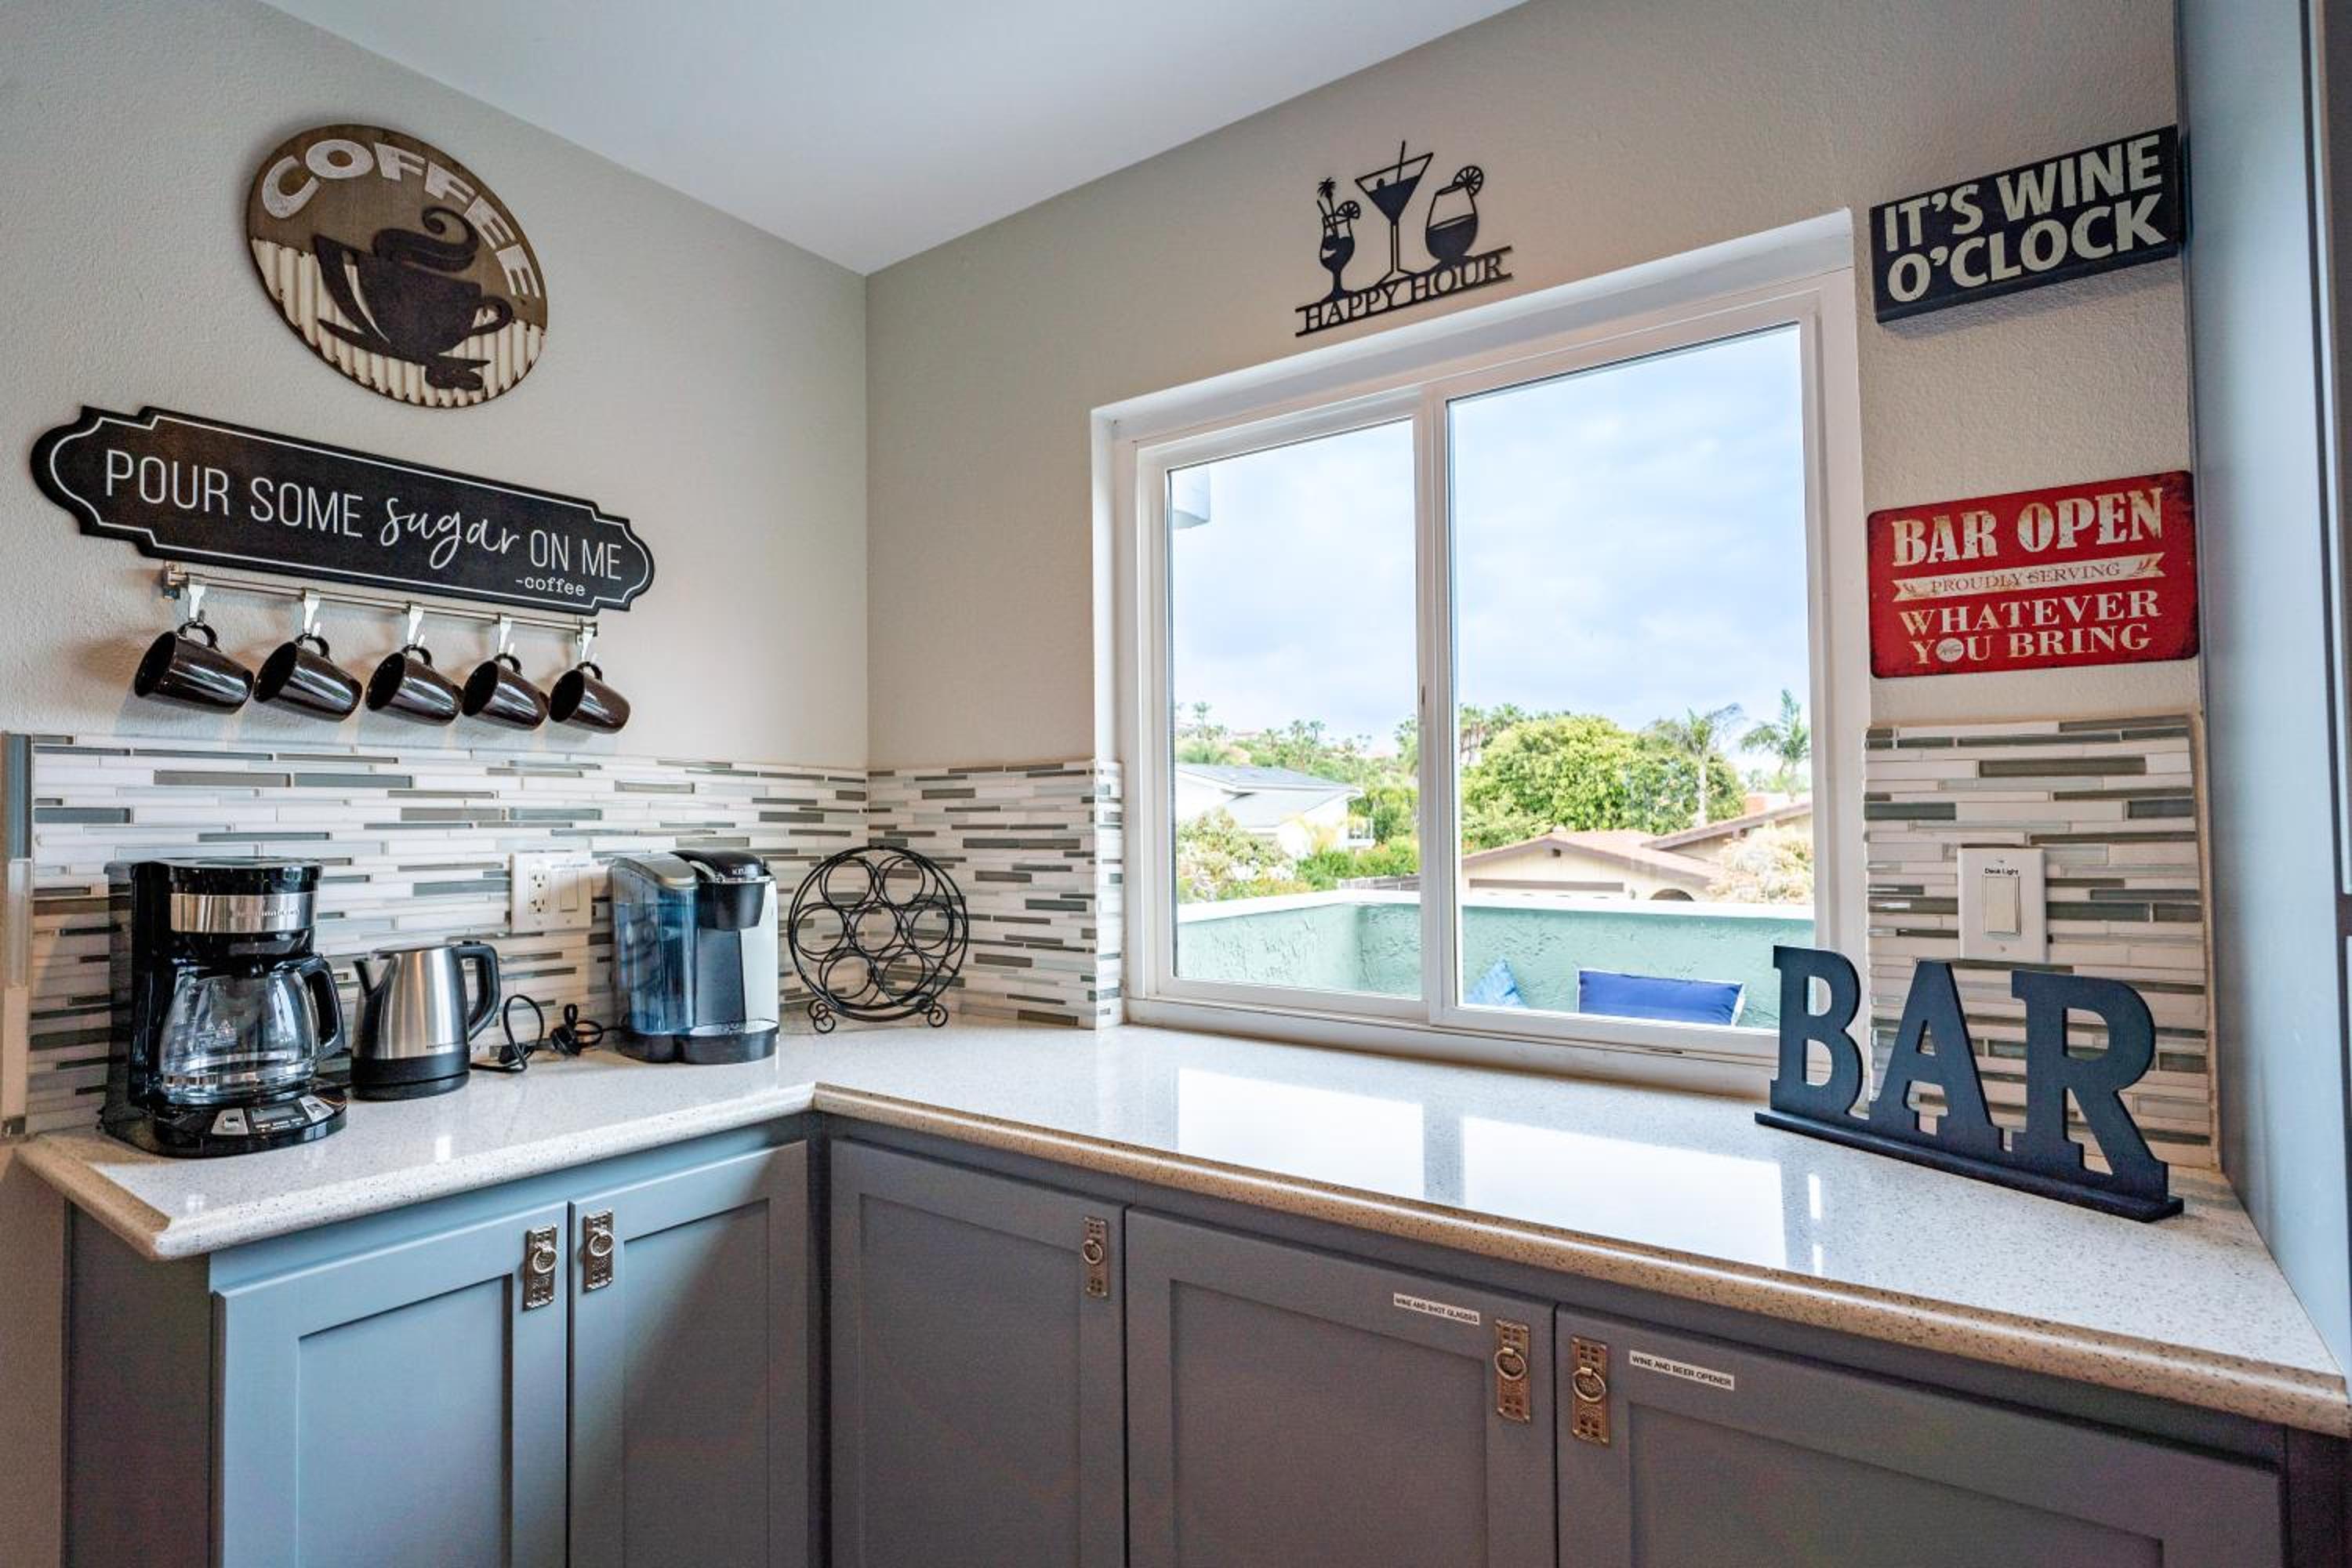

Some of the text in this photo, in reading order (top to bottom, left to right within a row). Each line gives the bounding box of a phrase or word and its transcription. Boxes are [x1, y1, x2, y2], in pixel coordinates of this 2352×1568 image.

[262, 139, 541, 299] COFFEE
[1884, 134, 2162, 252] IT'S WINE
[1887, 193, 2167, 303] O'CLOCK
[1303, 252, 1504, 332] HAPPY HOUR
[106, 448, 230, 516] POUR
[249, 476, 364, 539] SOME
[529, 529, 569, 572] ON
[581, 538, 622, 581] ME
[1891, 486, 2164, 568] BAR OPEN
[1898, 589, 2163, 637] WHATEVER
[1931, 562, 2122, 593] PROUDLY SERVING
[1908, 623, 2152, 664] YOU BRING
[1769, 945, 2169, 1202] BAR
[1632, 1355, 1732, 1387] WINE AND BEER OPENER
